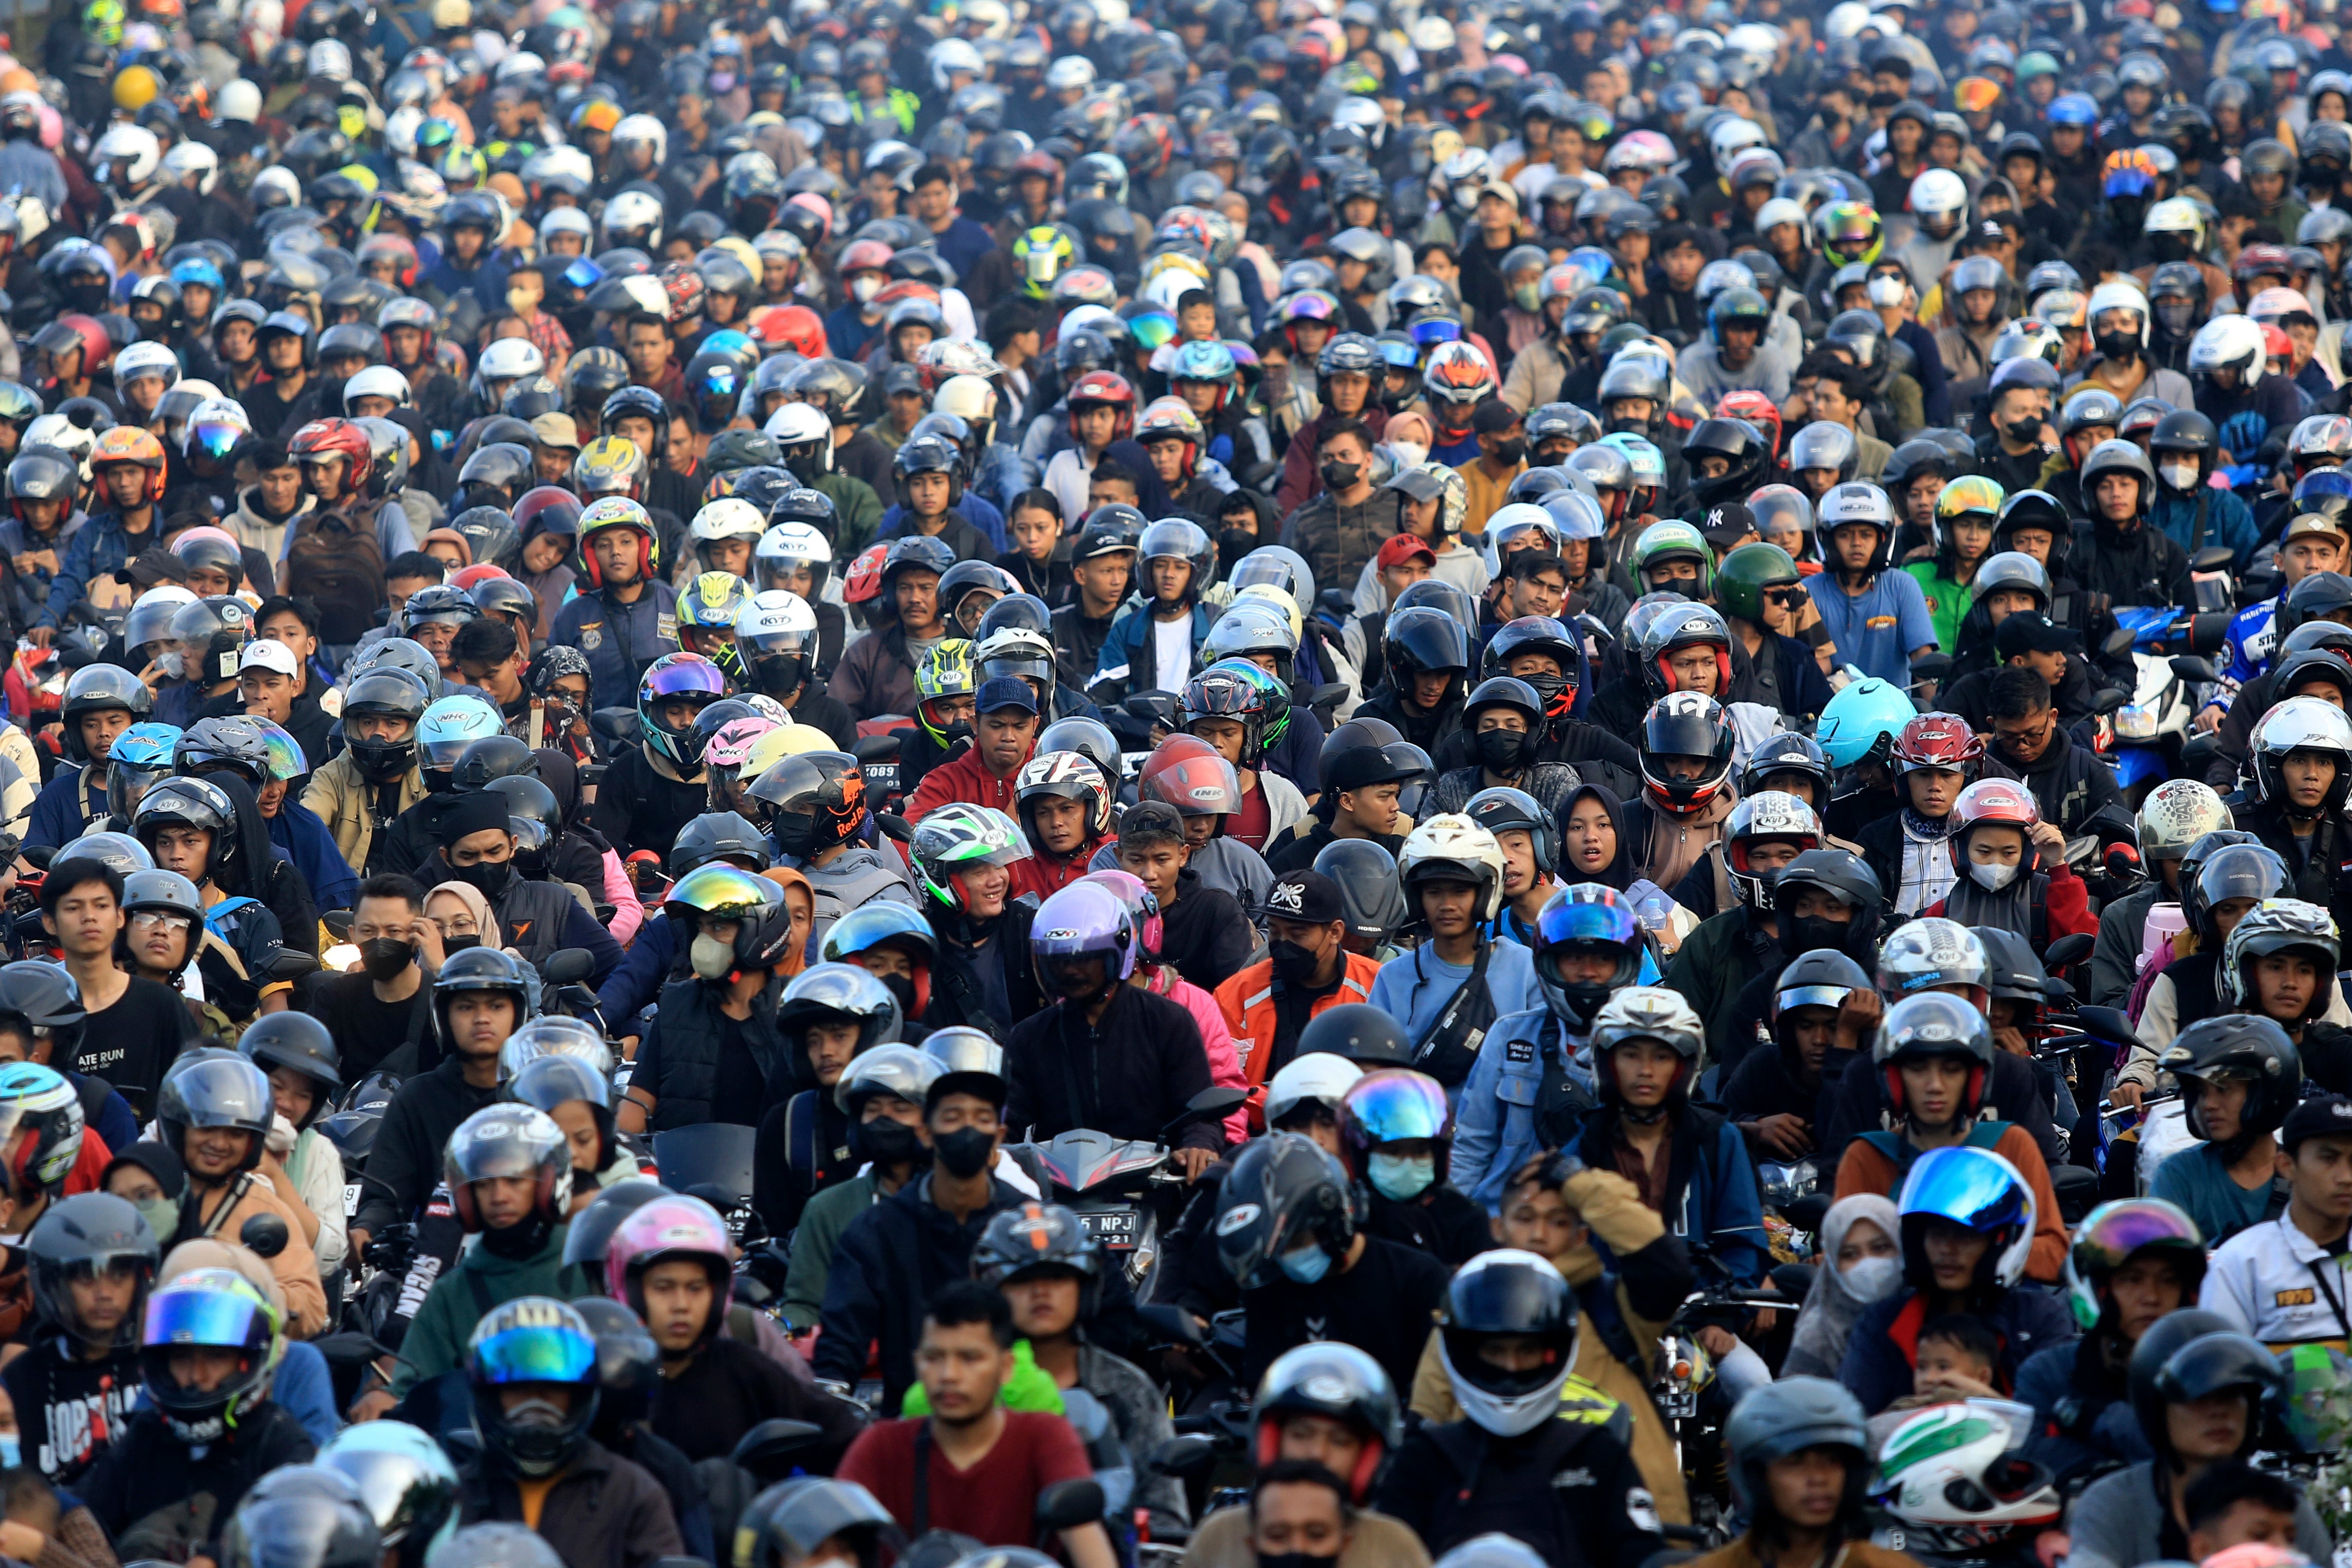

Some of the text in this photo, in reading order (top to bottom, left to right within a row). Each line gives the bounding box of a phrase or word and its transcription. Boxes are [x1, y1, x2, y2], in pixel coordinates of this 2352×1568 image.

[1707, 508, 1723, 527] NY
[837, 816, 857, 837] Red
[2177, 827, 2201, 836] GM
[100, 1048, 124, 1064] RUN
[1100, 1216, 1133, 1231] NPJ
